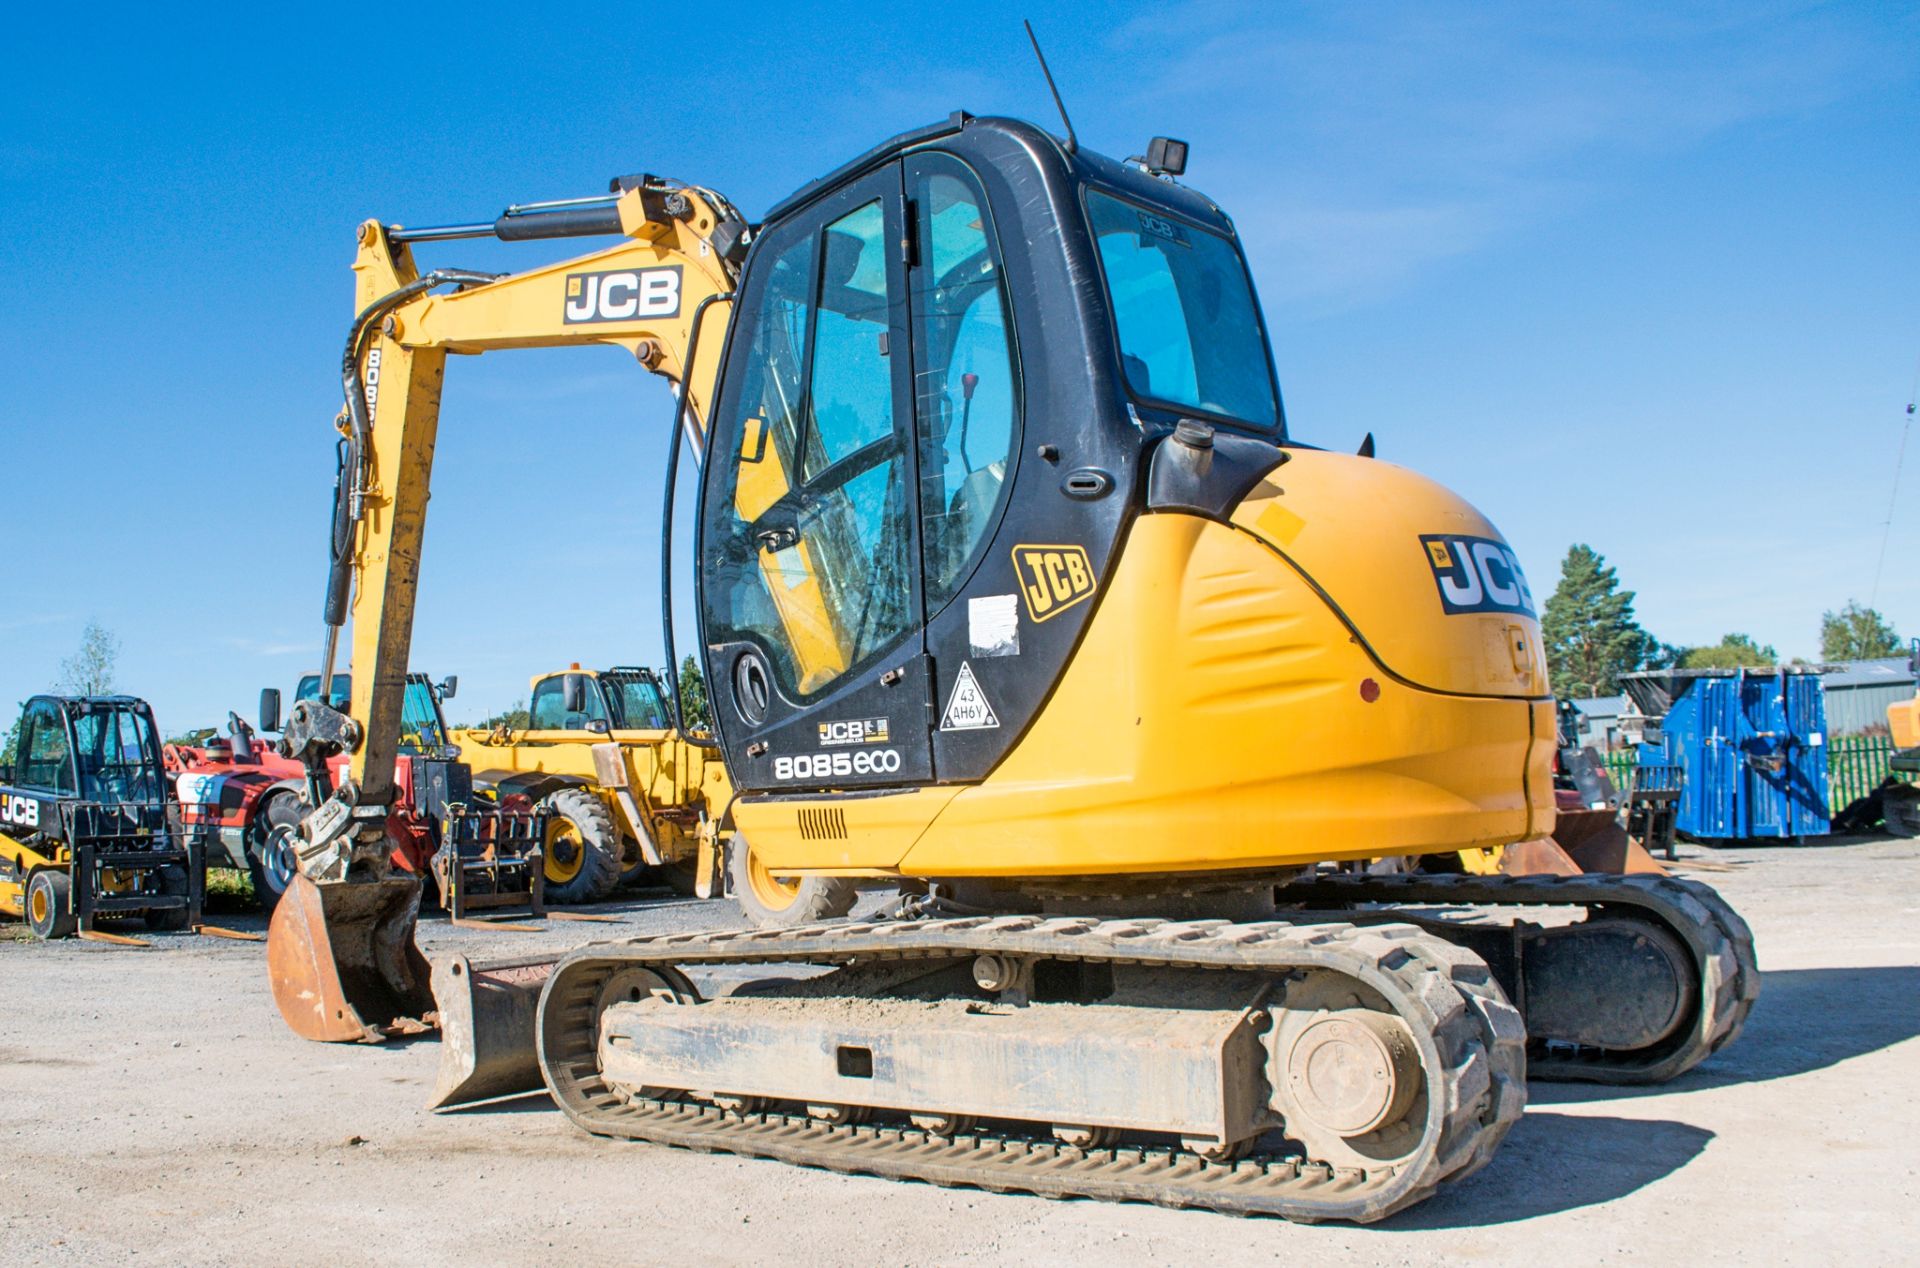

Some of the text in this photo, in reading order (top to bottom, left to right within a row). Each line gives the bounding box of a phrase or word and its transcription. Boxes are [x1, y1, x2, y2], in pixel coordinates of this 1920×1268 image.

[566, 270, 679, 321] JCB
[1024, 552, 1089, 613] JCB
[960, 688, 975, 703] 43
[953, 705, 983, 720] AH6Y
[819, 721, 864, 740] JCB
[2, 794, 39, 826] JCB
